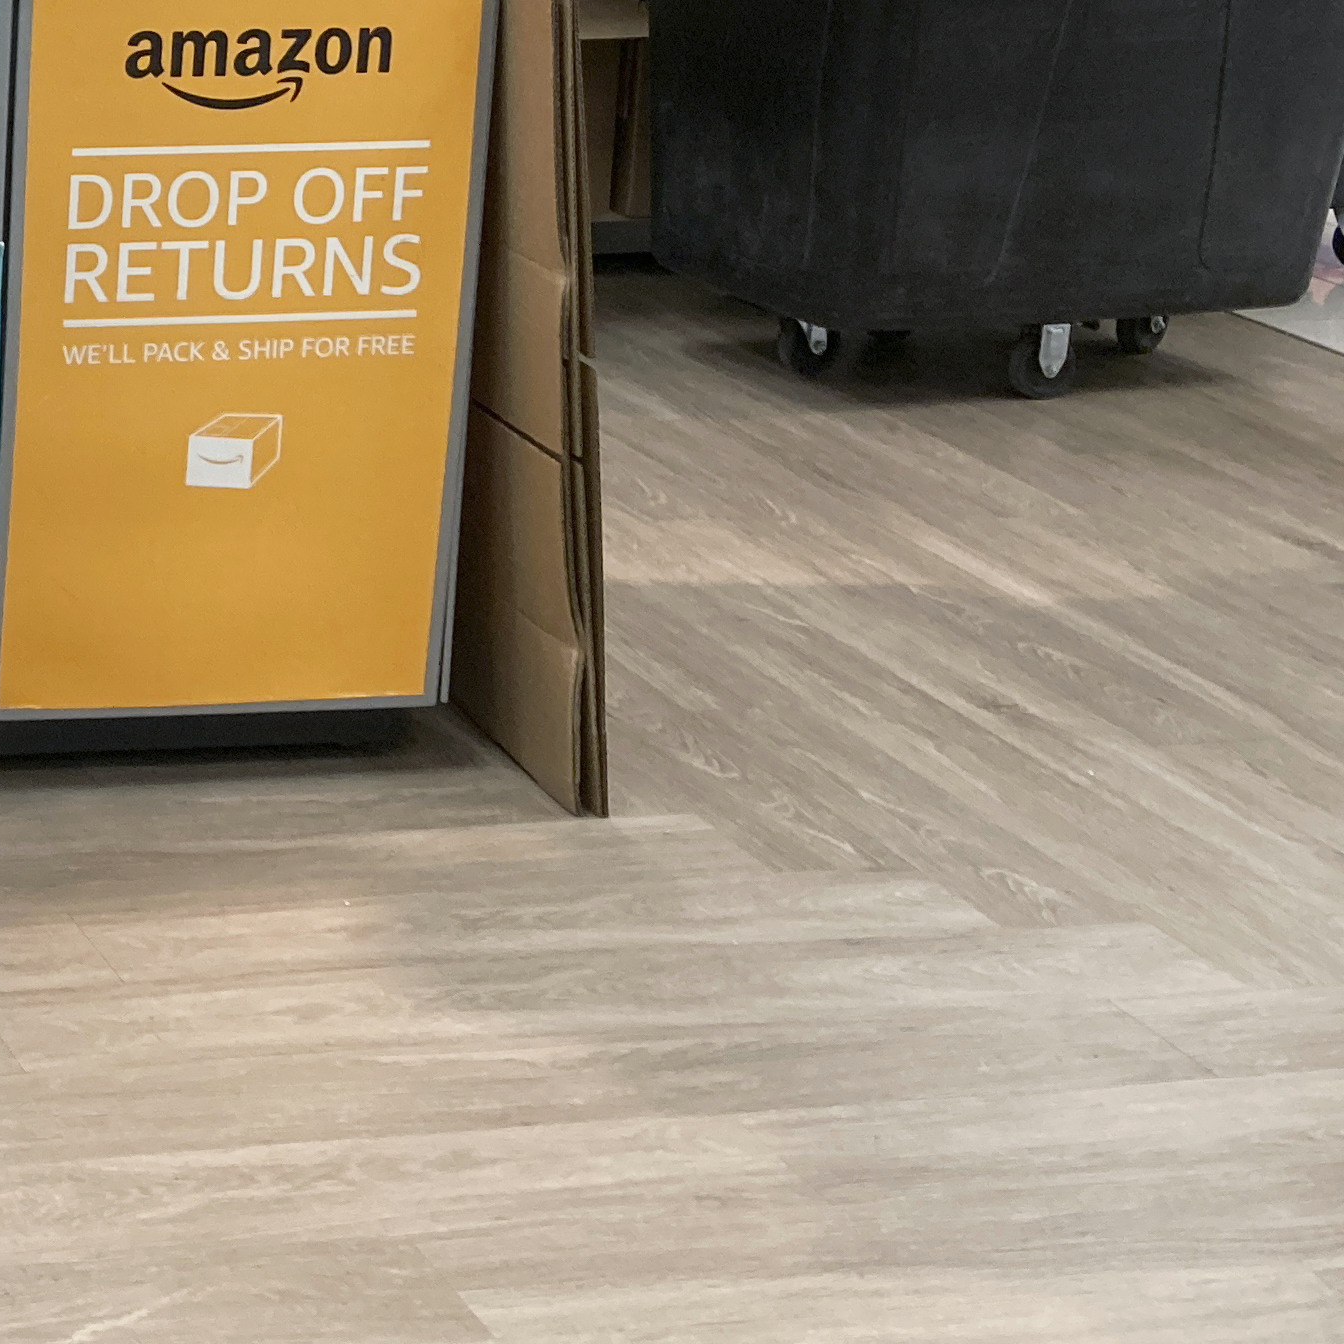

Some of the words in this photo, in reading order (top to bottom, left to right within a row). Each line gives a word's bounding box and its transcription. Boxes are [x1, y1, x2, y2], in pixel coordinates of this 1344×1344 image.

[125, 26, 392, 79] amazon
[68, 170, 268, 230] DROP
[293, 166, 429, 225] OFF
[64, 234, 421, 304] RETURNS
[63, 344, 136, 365] WE'LL
[143, 342, 204, 363] PACK
[212, 340, 230, 361] &
[238, 338, 294, 360] SHIP
[302, 337, 350, 358] FOR
[357, 335, 415, 356] FREE
